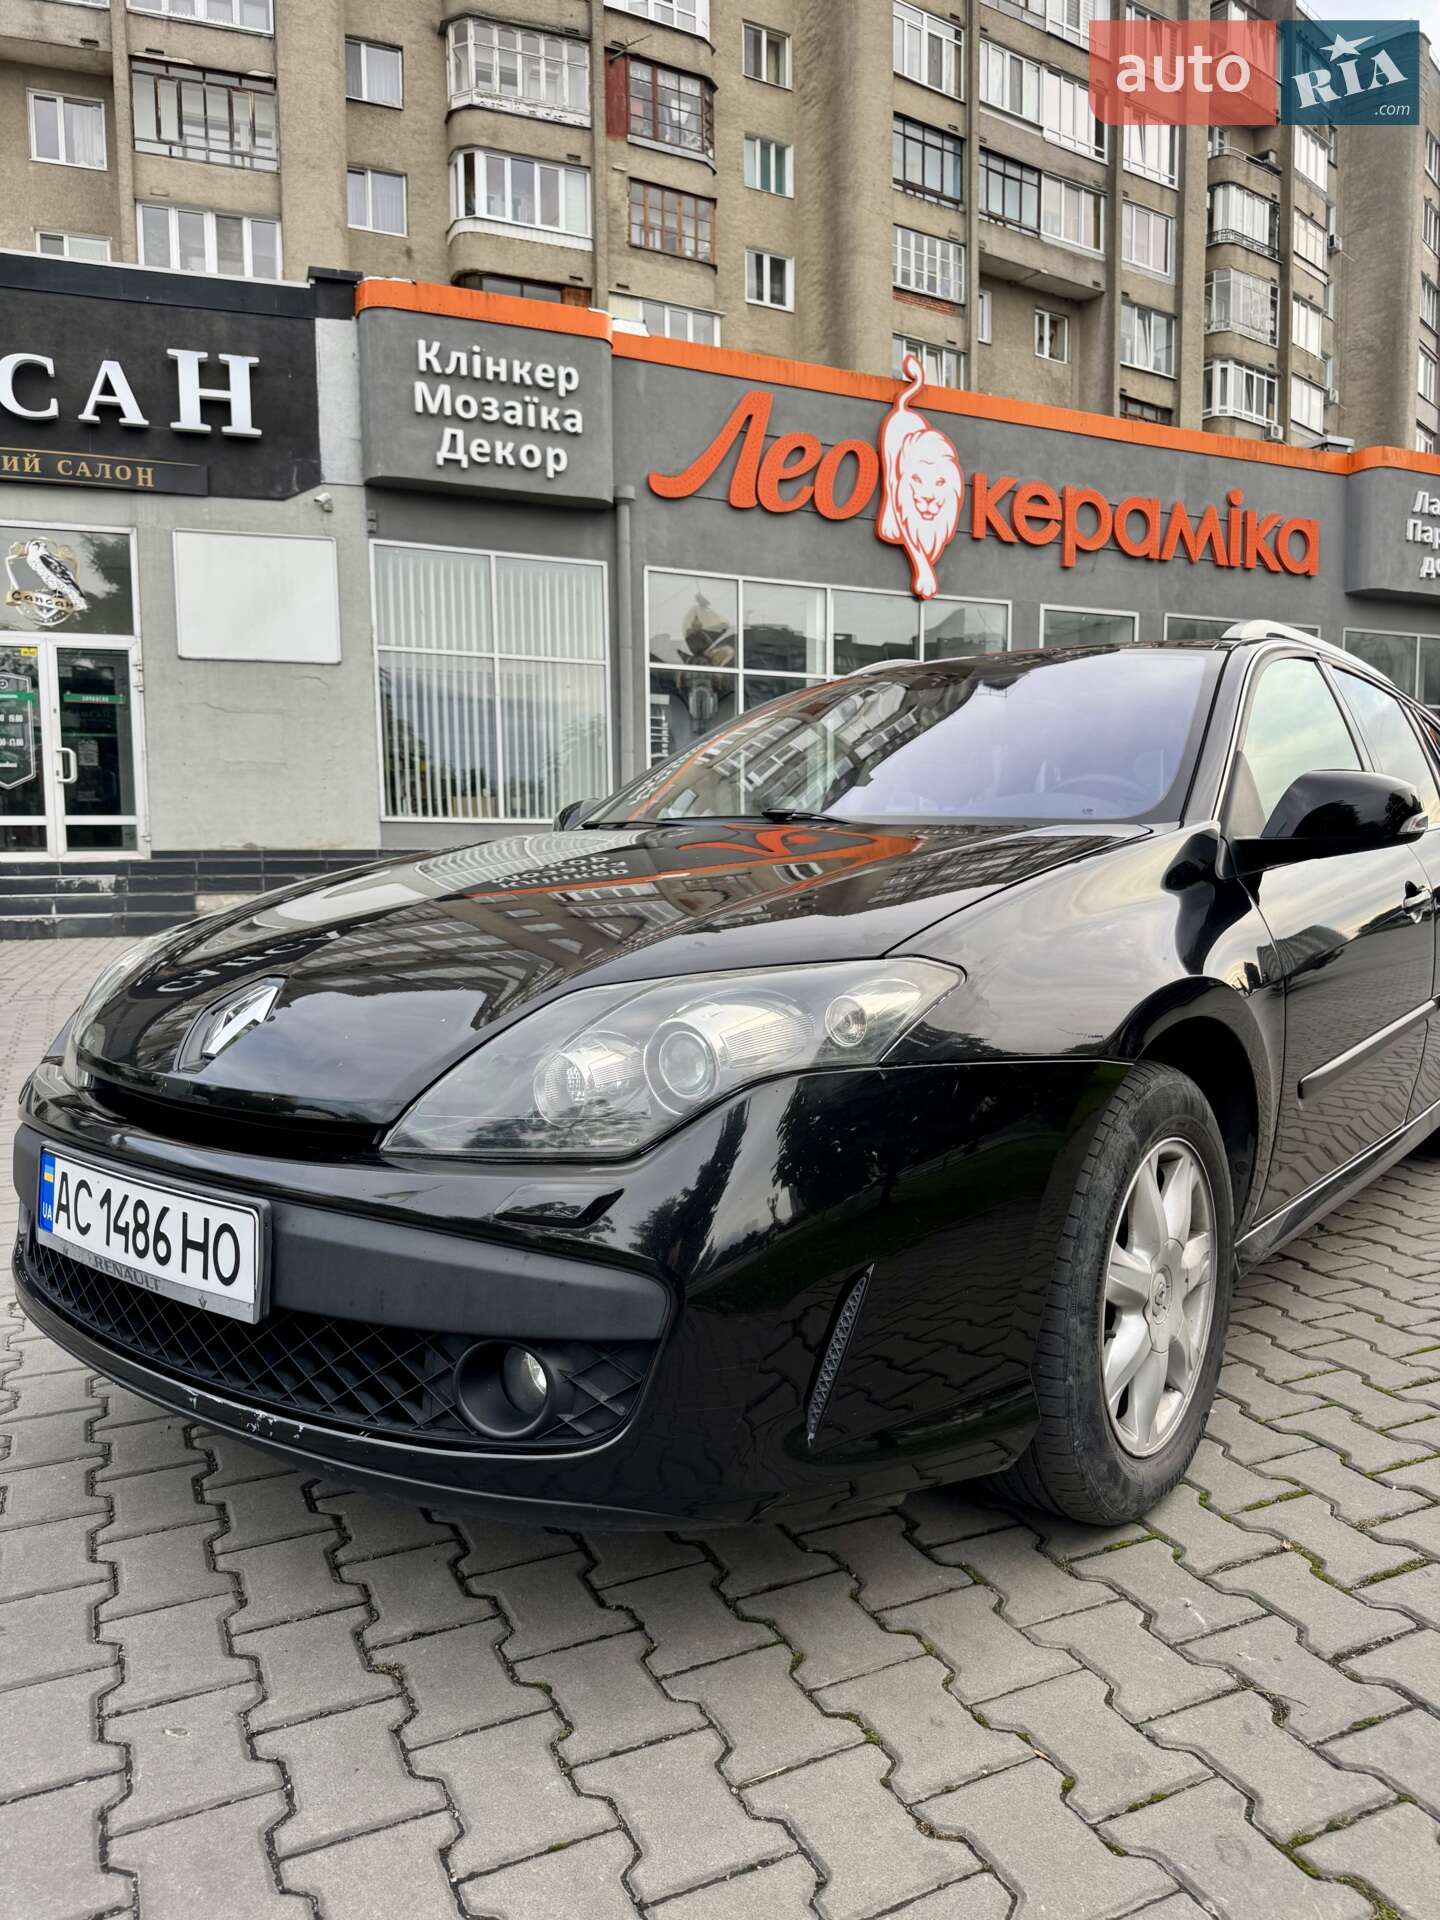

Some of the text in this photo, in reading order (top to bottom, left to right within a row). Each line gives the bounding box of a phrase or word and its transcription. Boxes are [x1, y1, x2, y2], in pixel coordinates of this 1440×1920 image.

[0, 348, 262, 438] САН
[417, 339, 580, 397] Клінкер
[413, 380, 584, 435] Мозаїка
[57, 459, 154, 487] САЛОН
[435, 427, 569, 479] Декор
[648, 391, 1320, 578] Лео кераміка
[41, 1206, 53, 1220] UA
[55, 1171, 241, 1287] AC 1486 HO
[94, 1255, 161, 1292] RENAULT
